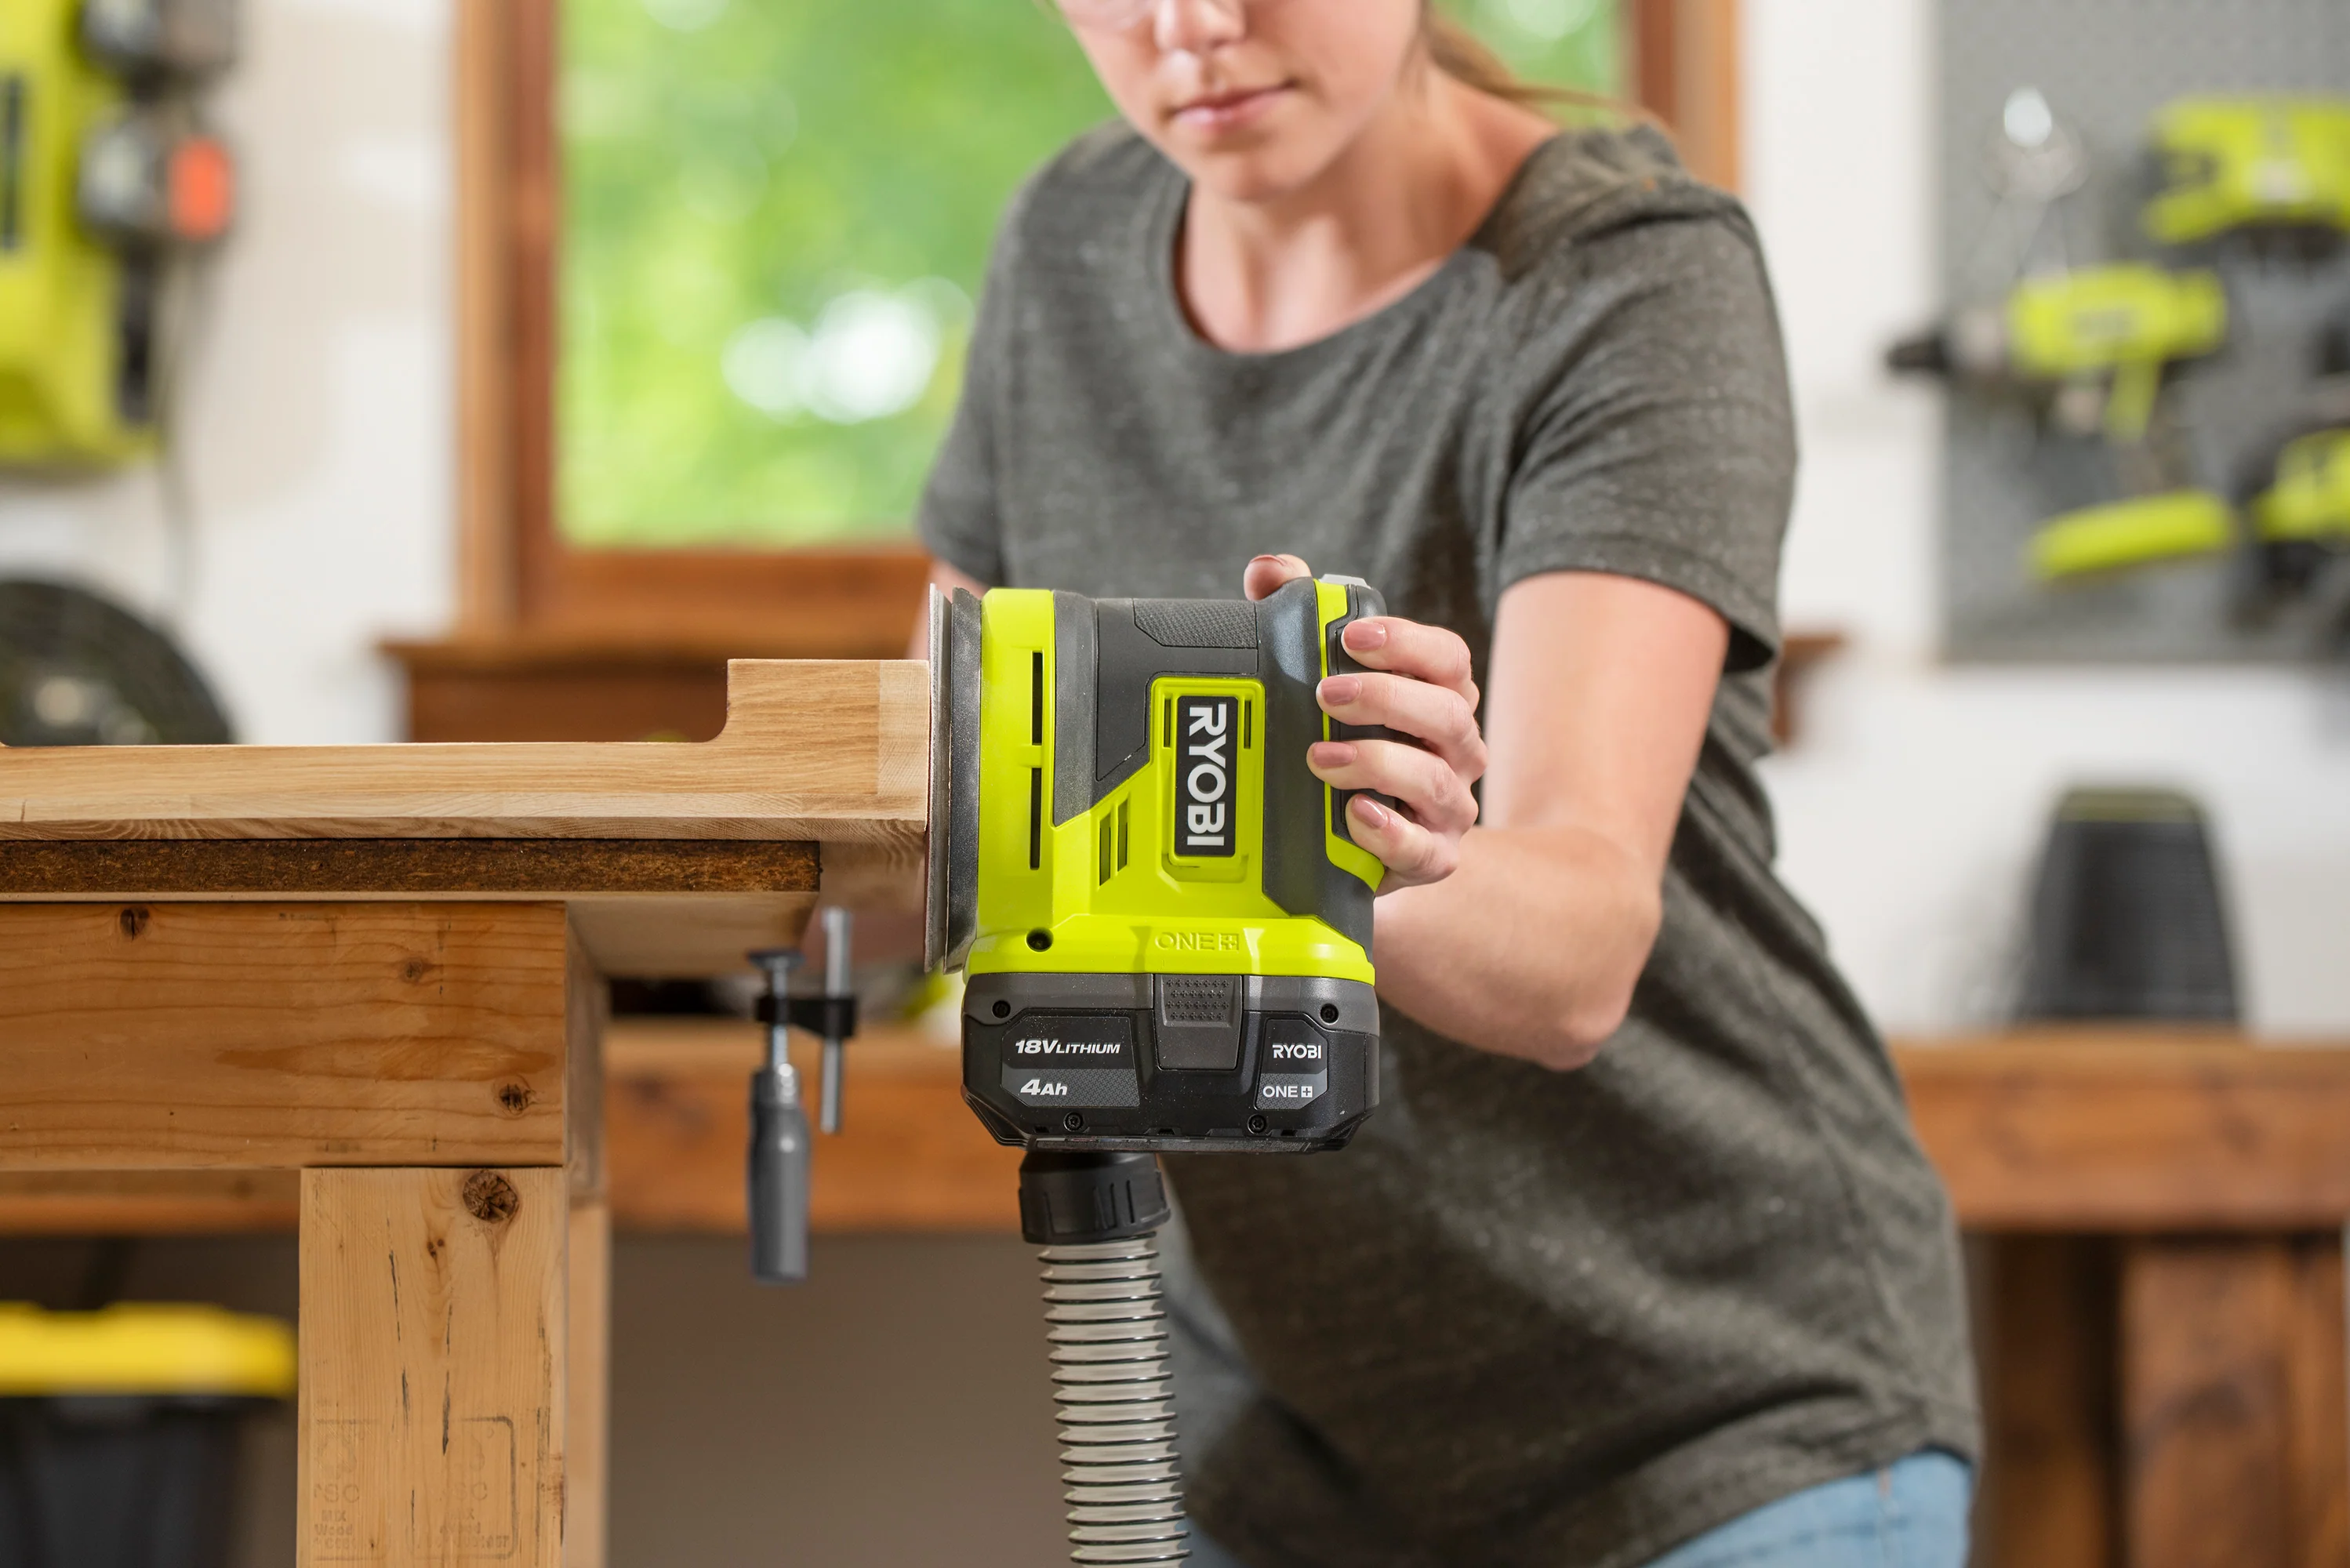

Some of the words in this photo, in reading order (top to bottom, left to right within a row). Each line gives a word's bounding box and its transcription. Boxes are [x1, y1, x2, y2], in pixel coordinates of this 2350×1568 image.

[1186, 703, 1227, 846] RYOBI
[1272, 1044, 1322, 1059] RYOBI
[1020, 1078, 1068, 1095] 4Ah
